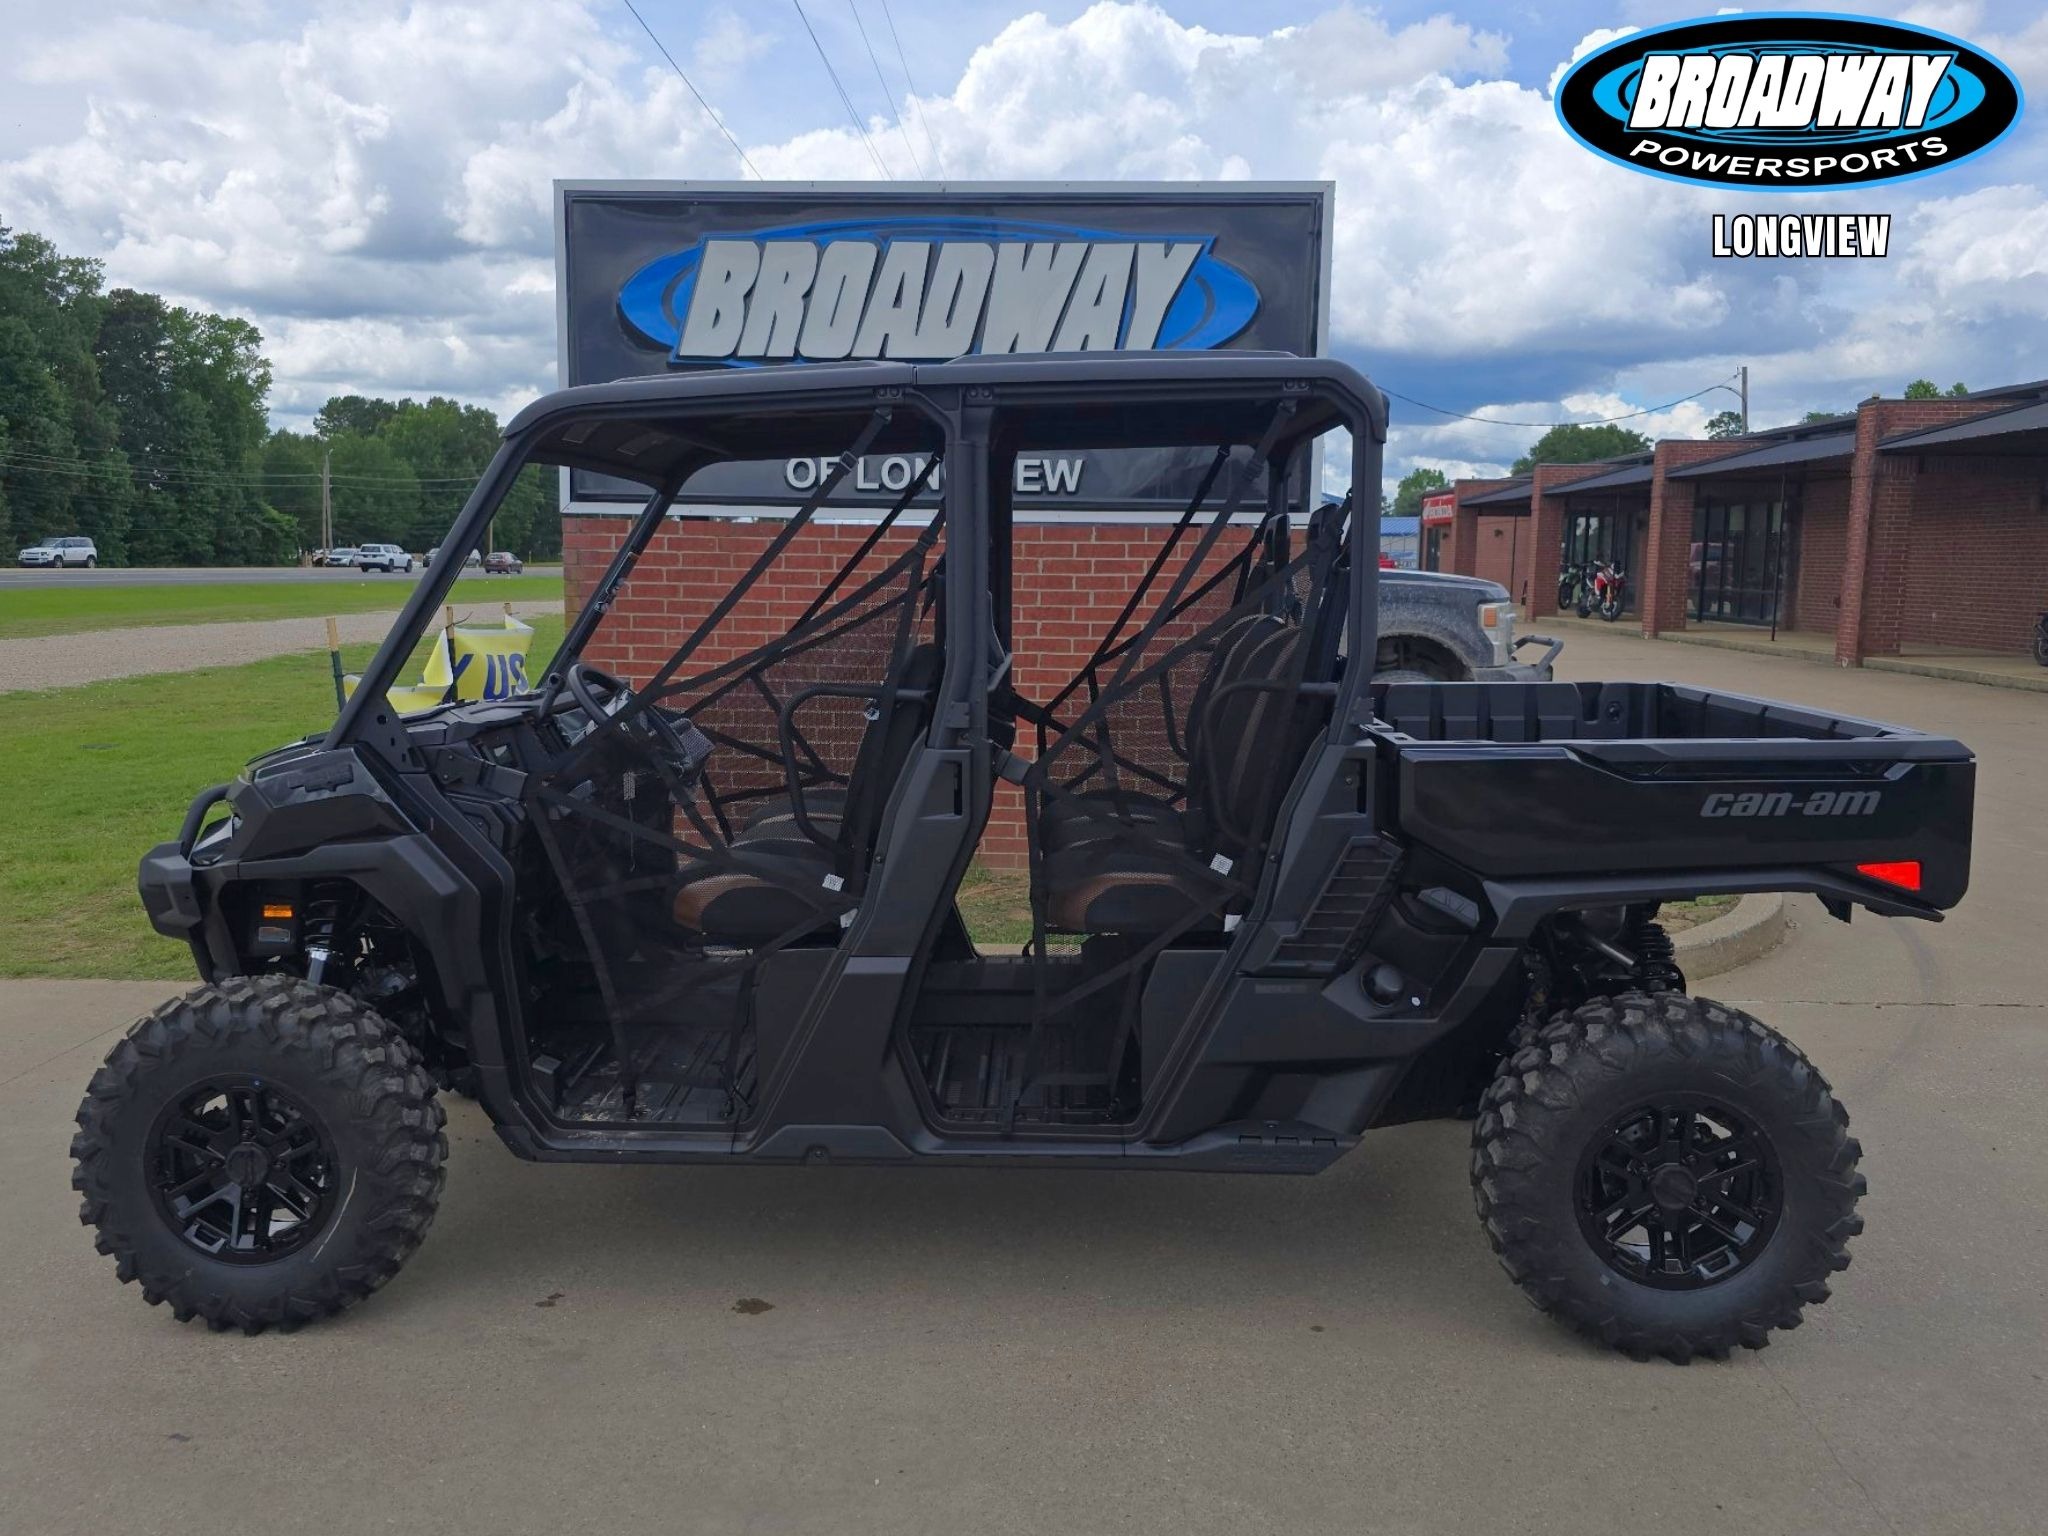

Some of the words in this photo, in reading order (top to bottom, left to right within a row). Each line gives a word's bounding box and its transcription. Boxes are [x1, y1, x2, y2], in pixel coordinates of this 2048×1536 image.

[679, 240, 1202, 358] BROADWAY
[856, 456, 1083, 492] LONEW
[483, 652, 529, 700] US
